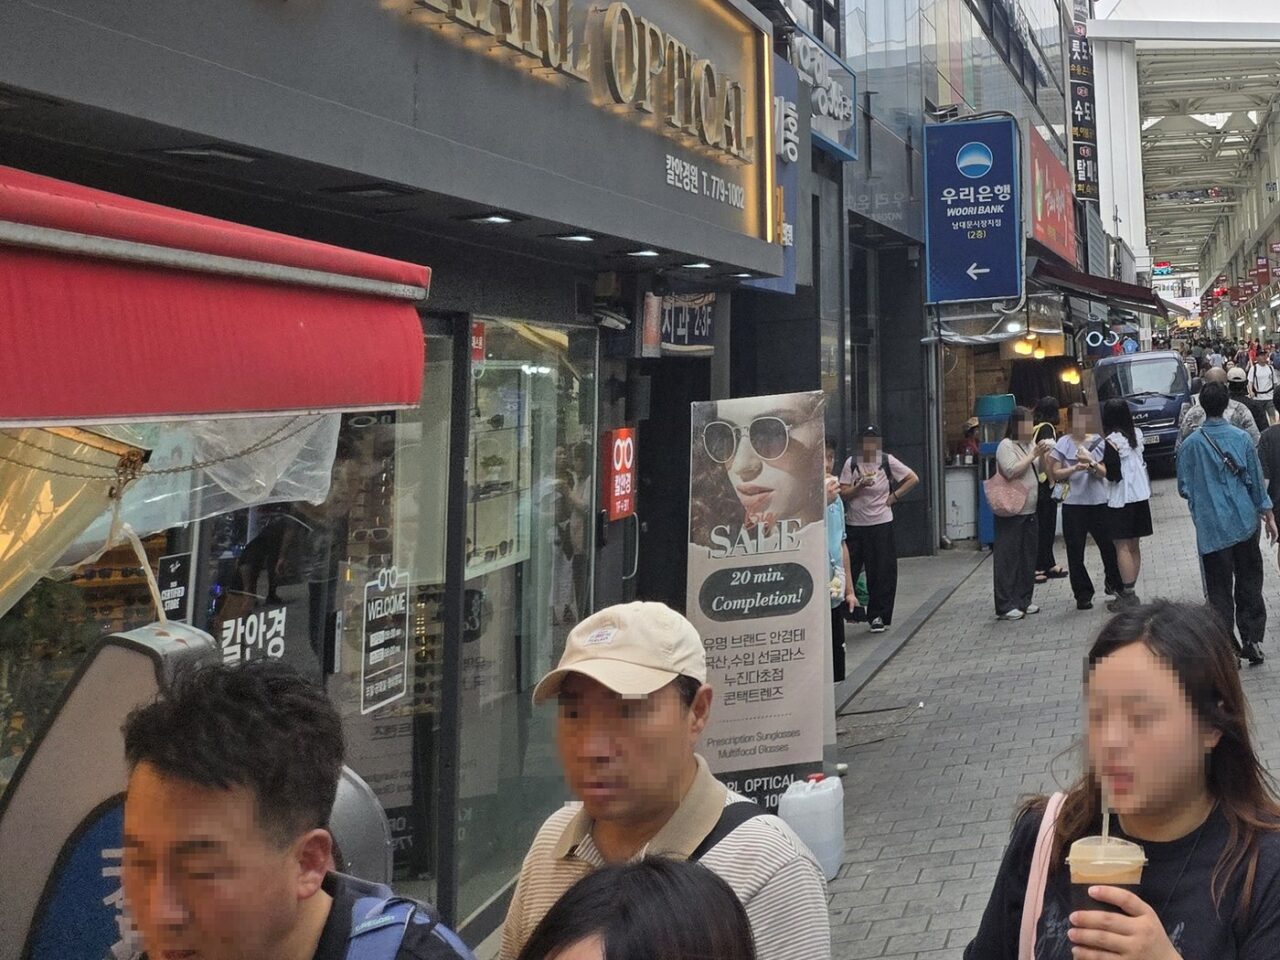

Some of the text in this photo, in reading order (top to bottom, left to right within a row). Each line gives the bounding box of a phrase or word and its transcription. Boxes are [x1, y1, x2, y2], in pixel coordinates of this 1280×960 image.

[940, 183, 1011, 205] 우리은행
[947, 204, 1005, 217] WOORI BANK
[710, 518, 802, 559] SALE
[730, 567, 785, 586] 20 min.
[367, 591, 406, 621] WELCOME
[711, 588, 803, 613] Completion!
[703, 628, 806, 651] 유명 브랜드 안경테
[758, 647, 806, 664] 선글라스
[724, 668, 785, 687] 누진다초점
[723, 686, 785, 706] 콘택트렌즈
